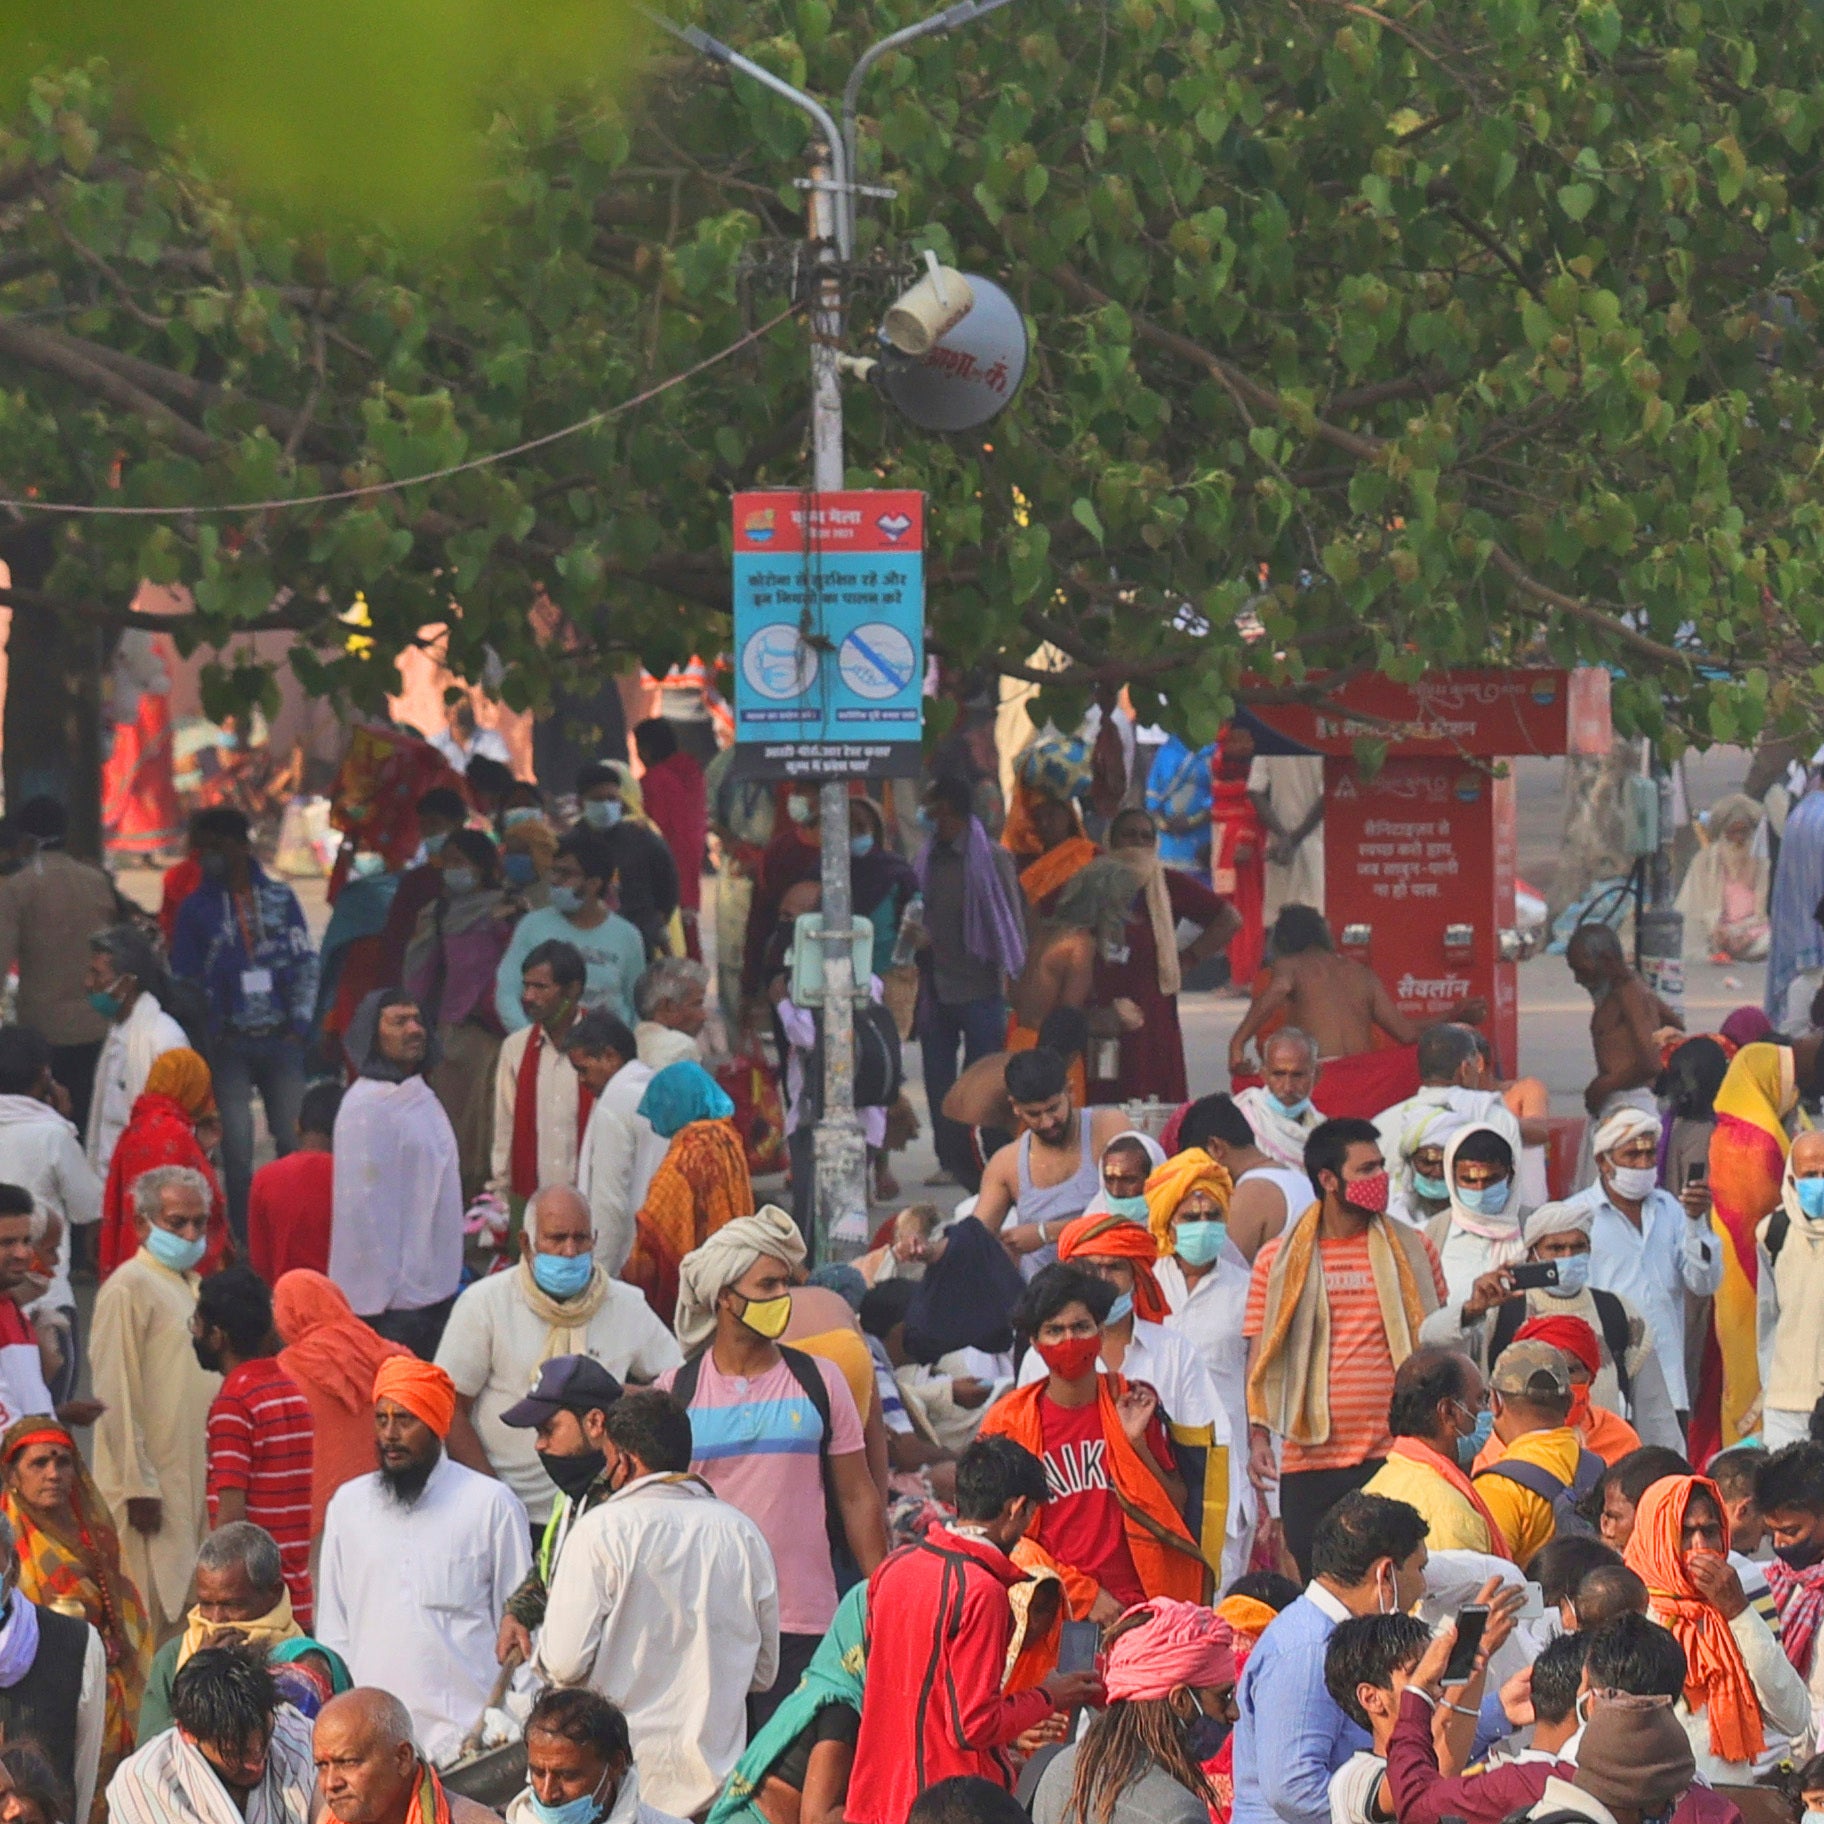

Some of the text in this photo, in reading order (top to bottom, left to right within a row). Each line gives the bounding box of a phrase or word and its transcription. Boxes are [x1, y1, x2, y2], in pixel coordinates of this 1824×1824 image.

[829, 506, 863, 525] मेला
[748, 570, 791, 586] कोरोना
[882, 568, 907, 586] और
[842, 592, 878, 606] पालन
[1438, 818, 1451, 836] से
[1356, 861, 1380, 875] जब
[1392, 879, 1408, 900] हो
[1396, 971, 1472, 999] सैवलॉन
[1042, 1439, 1115, 1505] NIK
